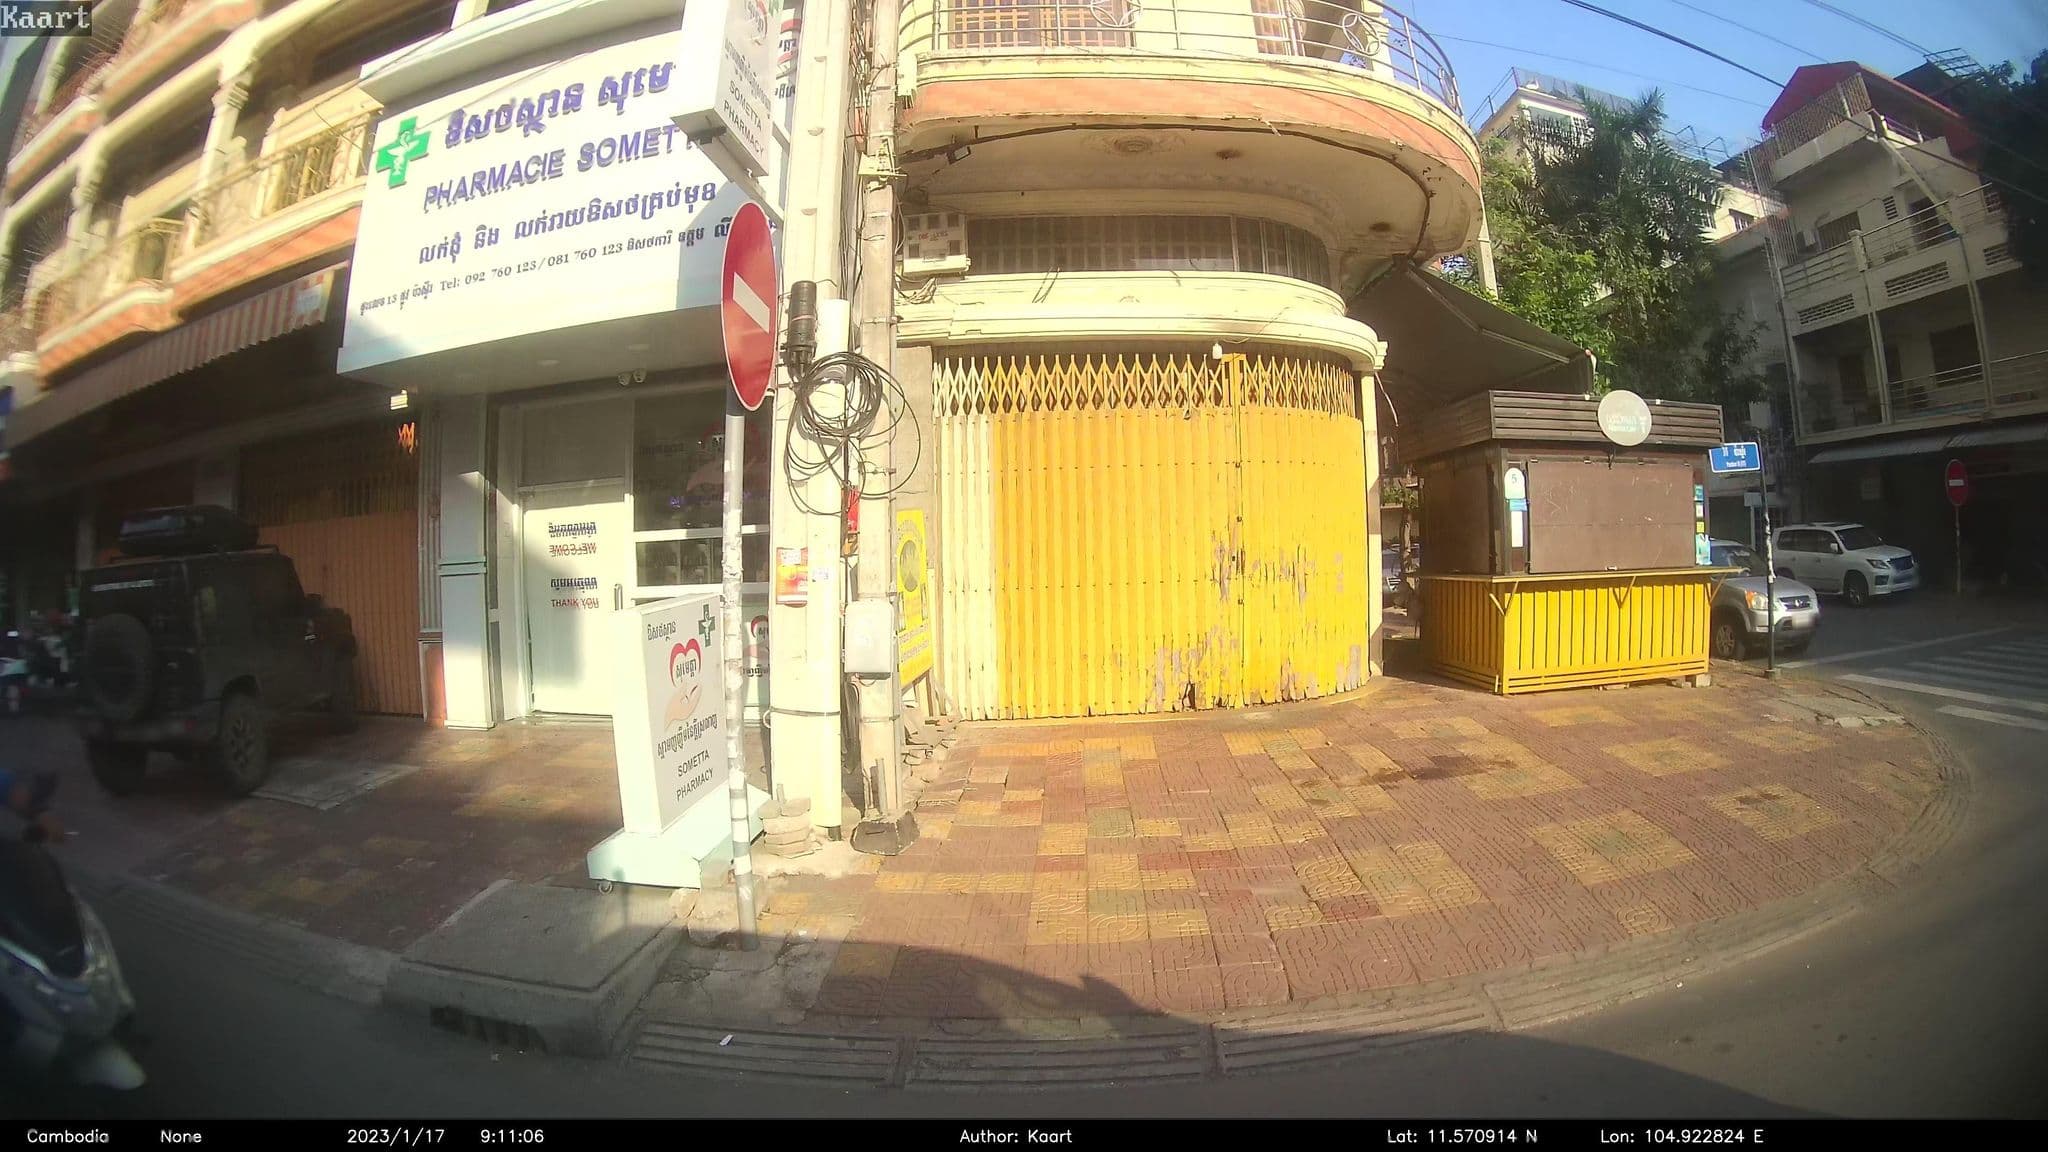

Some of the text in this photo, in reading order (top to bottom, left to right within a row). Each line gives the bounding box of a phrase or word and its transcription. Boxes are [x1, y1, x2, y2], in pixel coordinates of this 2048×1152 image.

[729, 81, 763, 132] SOMETTA
[723, 100, 765, 158] PHARMACY
[423, 124, 694, 214] PHARMACIE SOMET
[473, 224, 500, 249] និង
[440, 277, 461, 291] Tel:
[464, 271, 486, 286] 092
[491, 265, 512, 279] 760
[574, 247, 597, 261] 760
[602, 243, 623, 256] 123
[551, 598, 599, 609] THANK YOU
[678, 749, 710, 777] SOMETTA
[676, 767, 714, 802] PHARMACY
